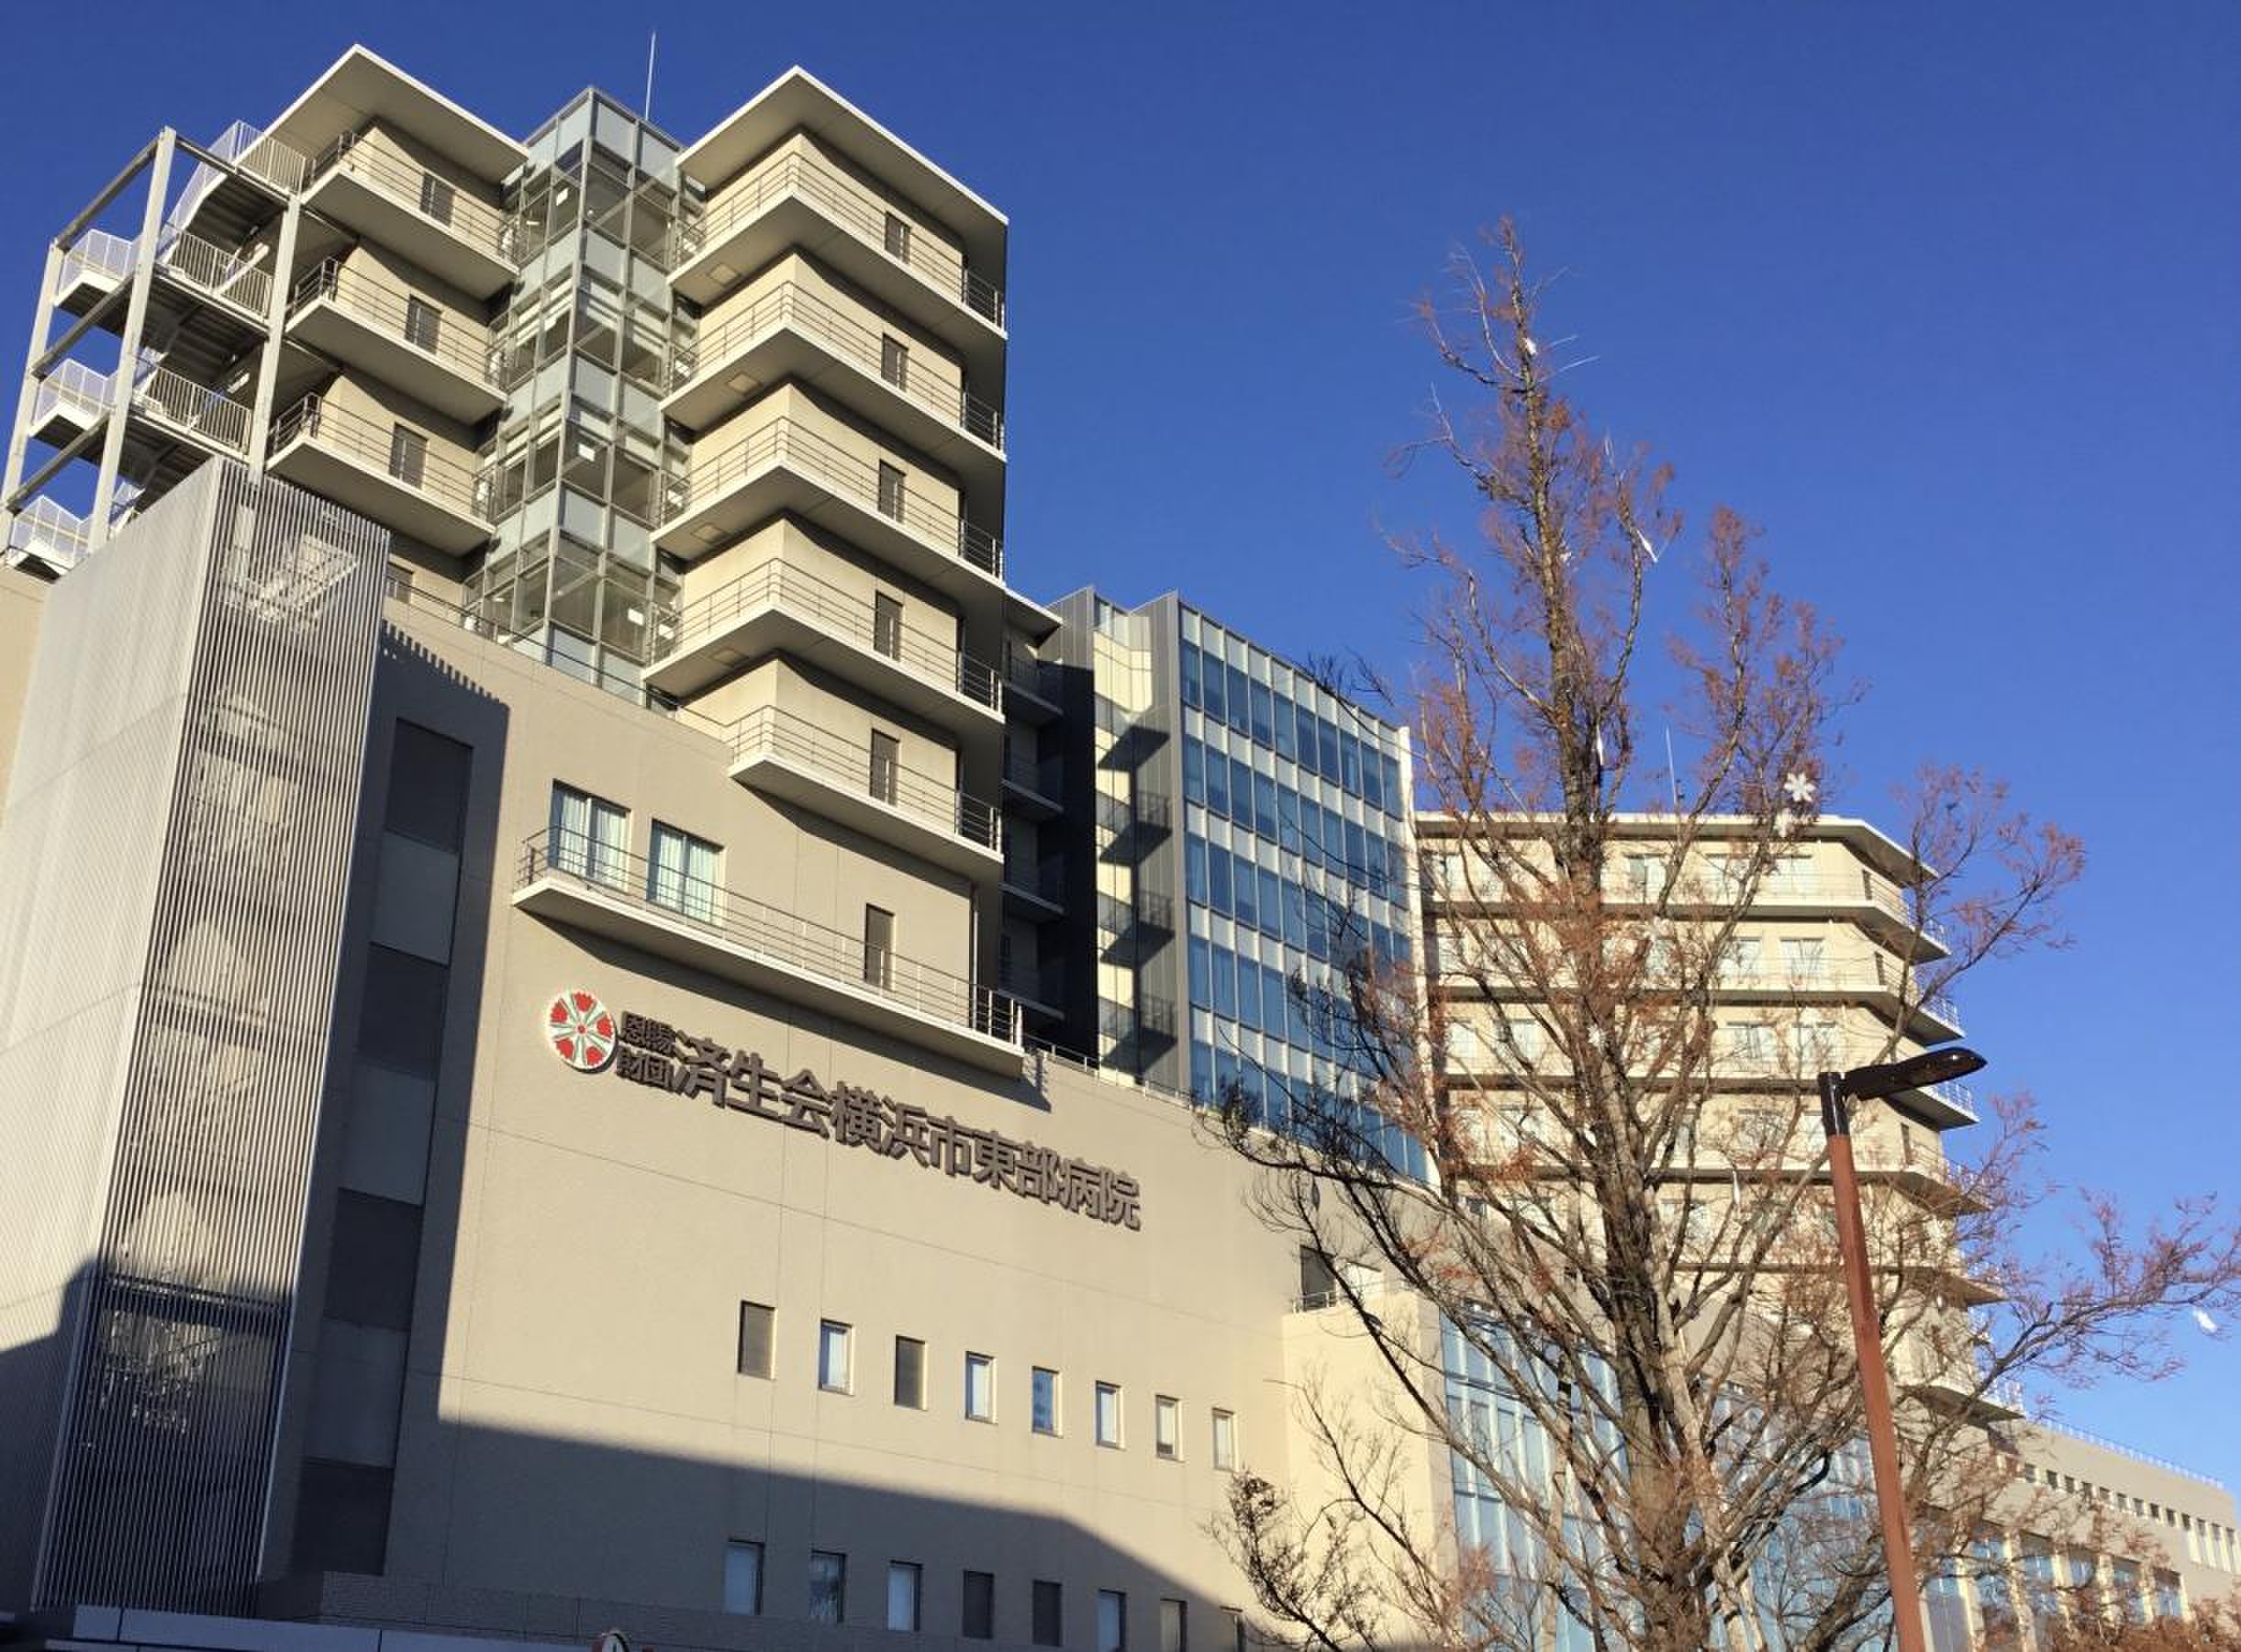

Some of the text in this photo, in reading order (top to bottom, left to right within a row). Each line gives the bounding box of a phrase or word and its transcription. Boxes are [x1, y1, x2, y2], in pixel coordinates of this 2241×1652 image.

[621, 1010, 676, 1058] 恩賜
[616, 1044, 675, 1094] 財団
[675, 1029, 1142, 1232] 済生会横浜市東部病院
